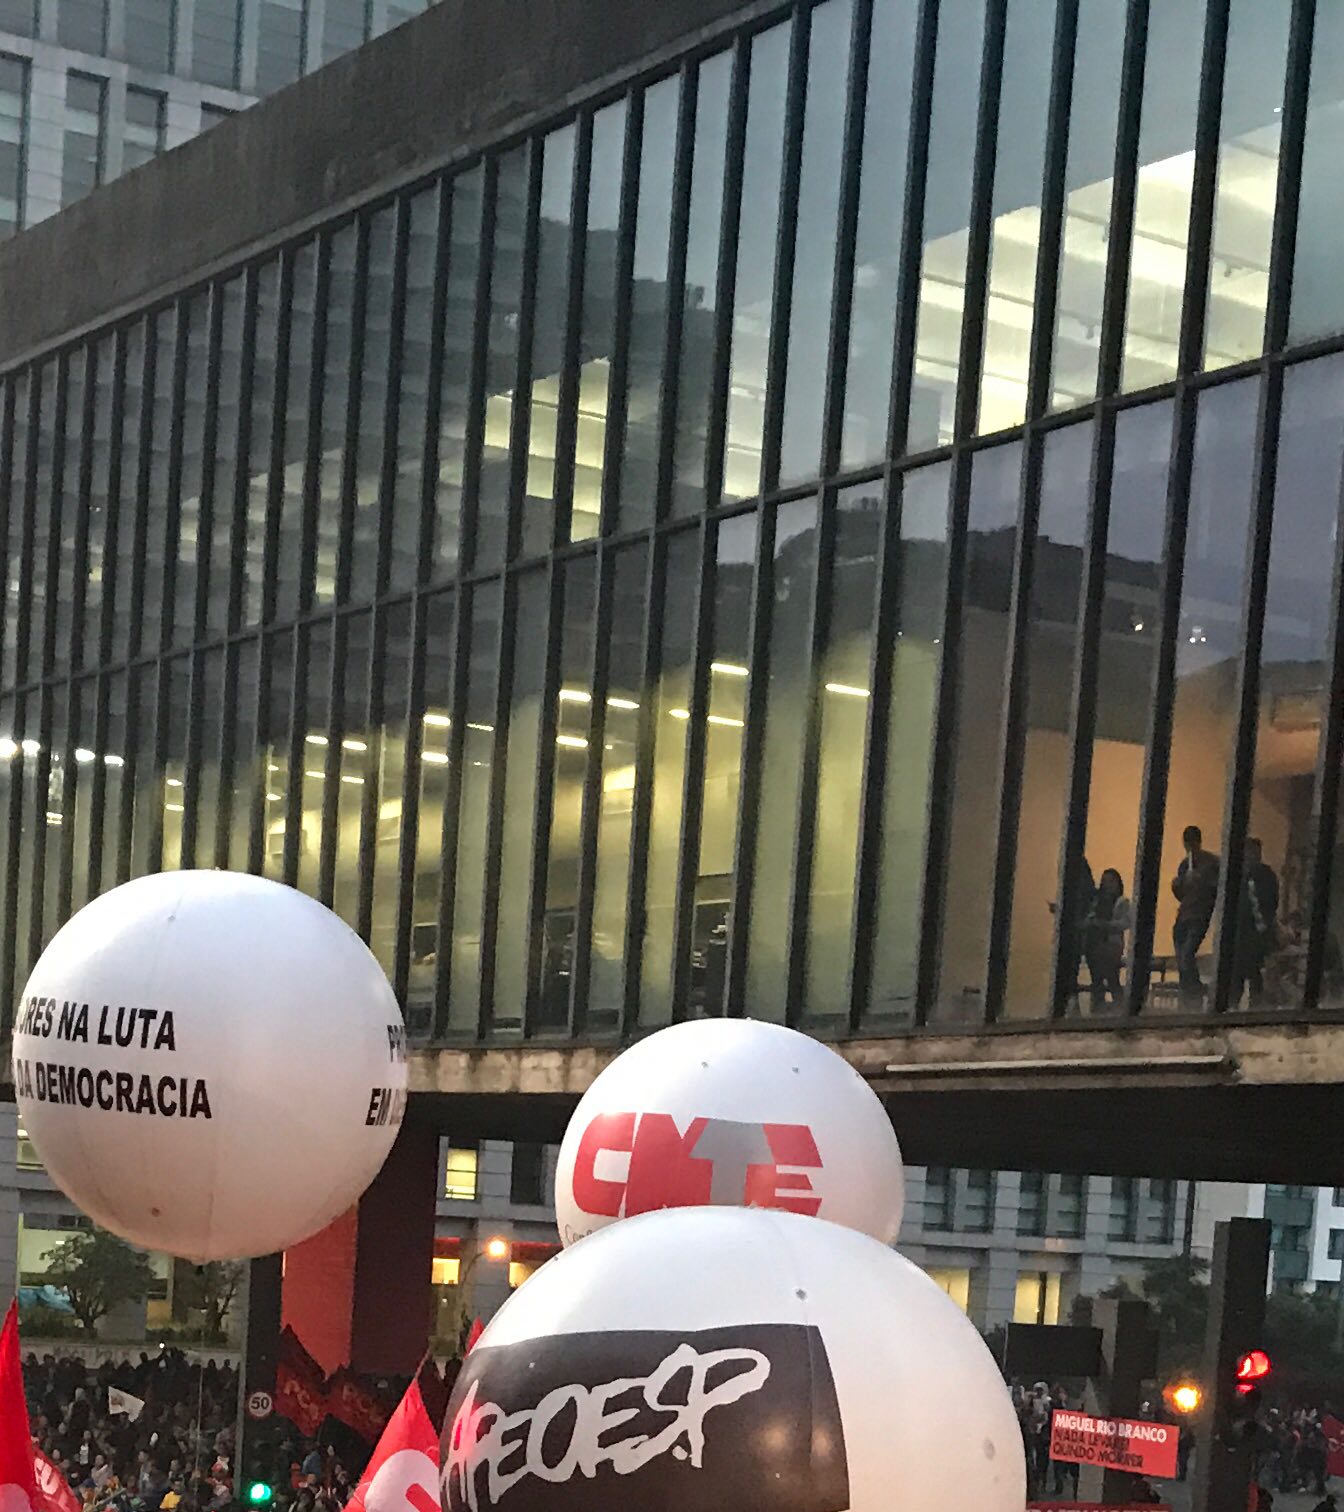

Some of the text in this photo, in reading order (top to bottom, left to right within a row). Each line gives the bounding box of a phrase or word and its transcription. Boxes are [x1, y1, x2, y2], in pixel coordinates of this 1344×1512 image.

[57, 1001, 88, 1043] NA
[98, 1005, 176, 1051] LUTA
[35, 1061, 212, 1120] DEMOCRACIA
[250, 1396, 270, 1410] 50
[1055, 1413, 1167, 1443] MIGUEL RIO BRANCO
